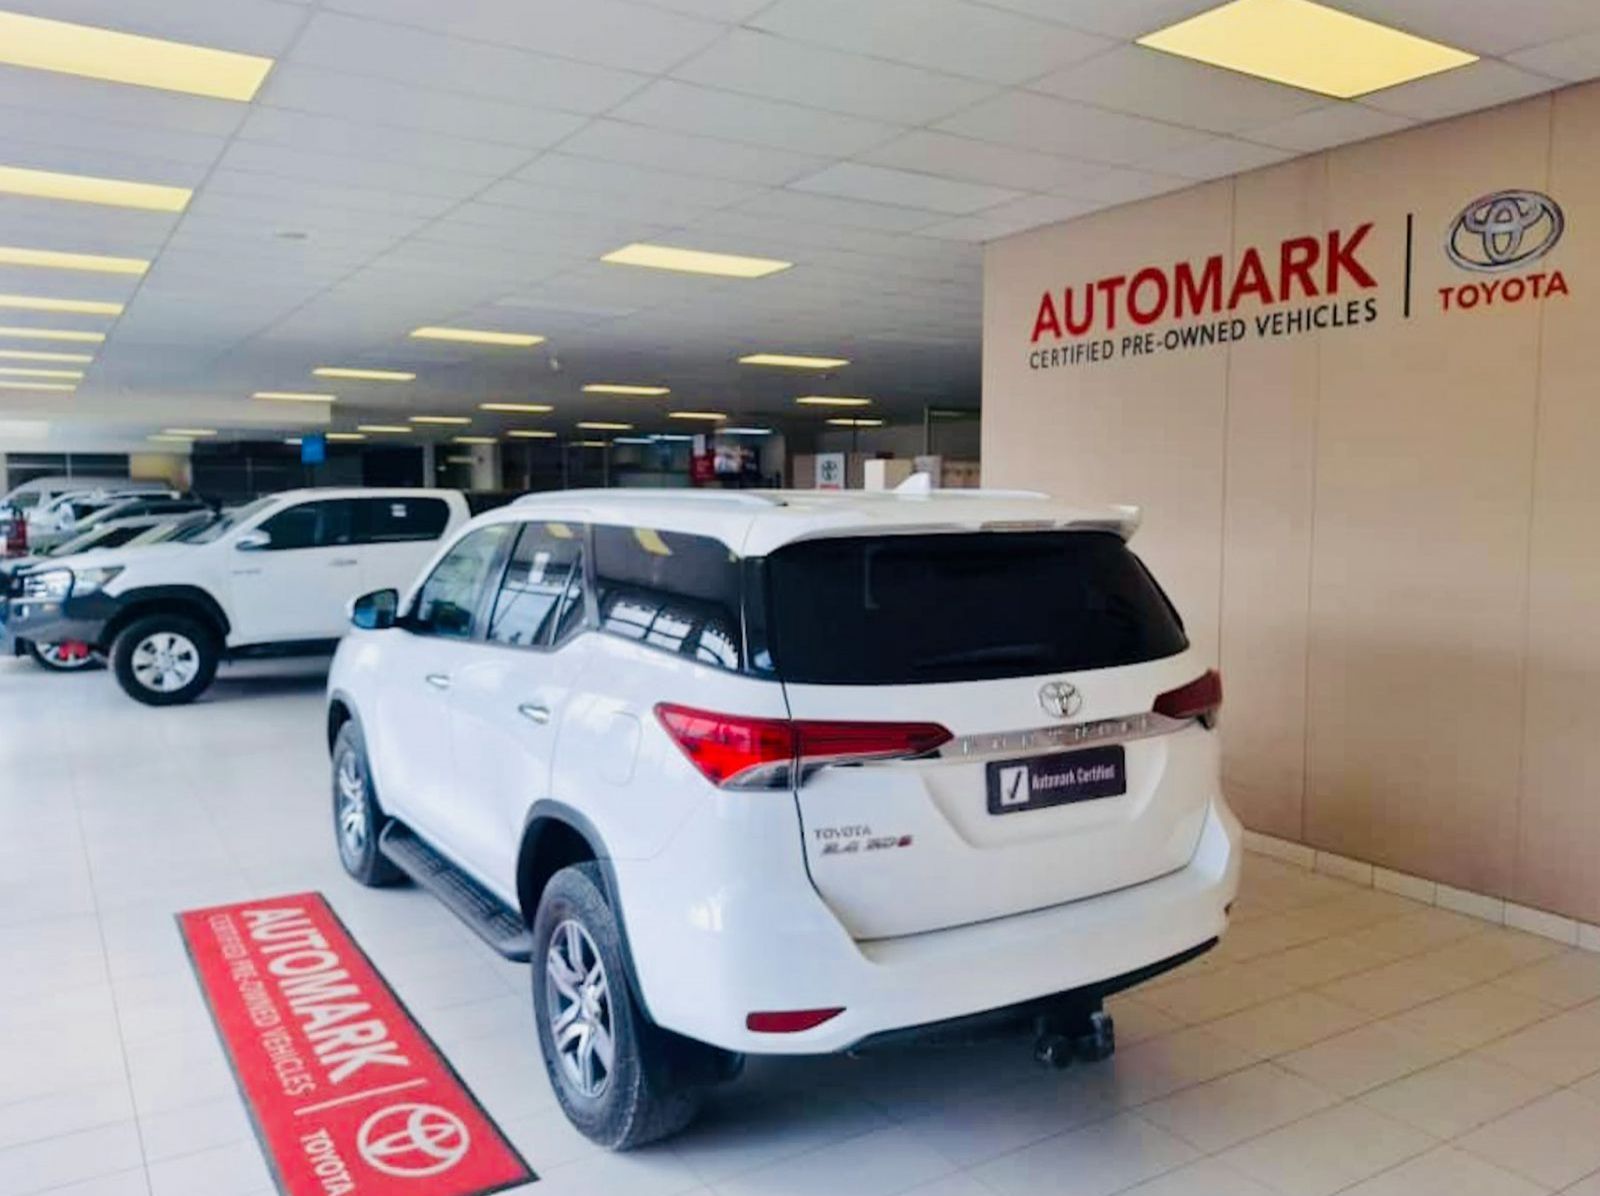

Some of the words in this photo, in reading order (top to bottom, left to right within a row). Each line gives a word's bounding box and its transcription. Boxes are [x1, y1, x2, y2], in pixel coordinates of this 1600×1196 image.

[1030, 222, 1378, 343] AUTOMARK
[1438, 270, 1569, 311] TOYOTA
[1029, 339, 1114, 370] CERTIFIED
[1121, 318, 1246, 358] PRE-OWNED
[1255, 297, 1378, 337] VEHICLES
[814, 825, 872, 839] TOYOTA
[240, 907, 409, 1086] AUTOMARK
[261, 1025, 317, 1096] VEHICLES
[300, 1127, 355, 1196] TOYOTA
